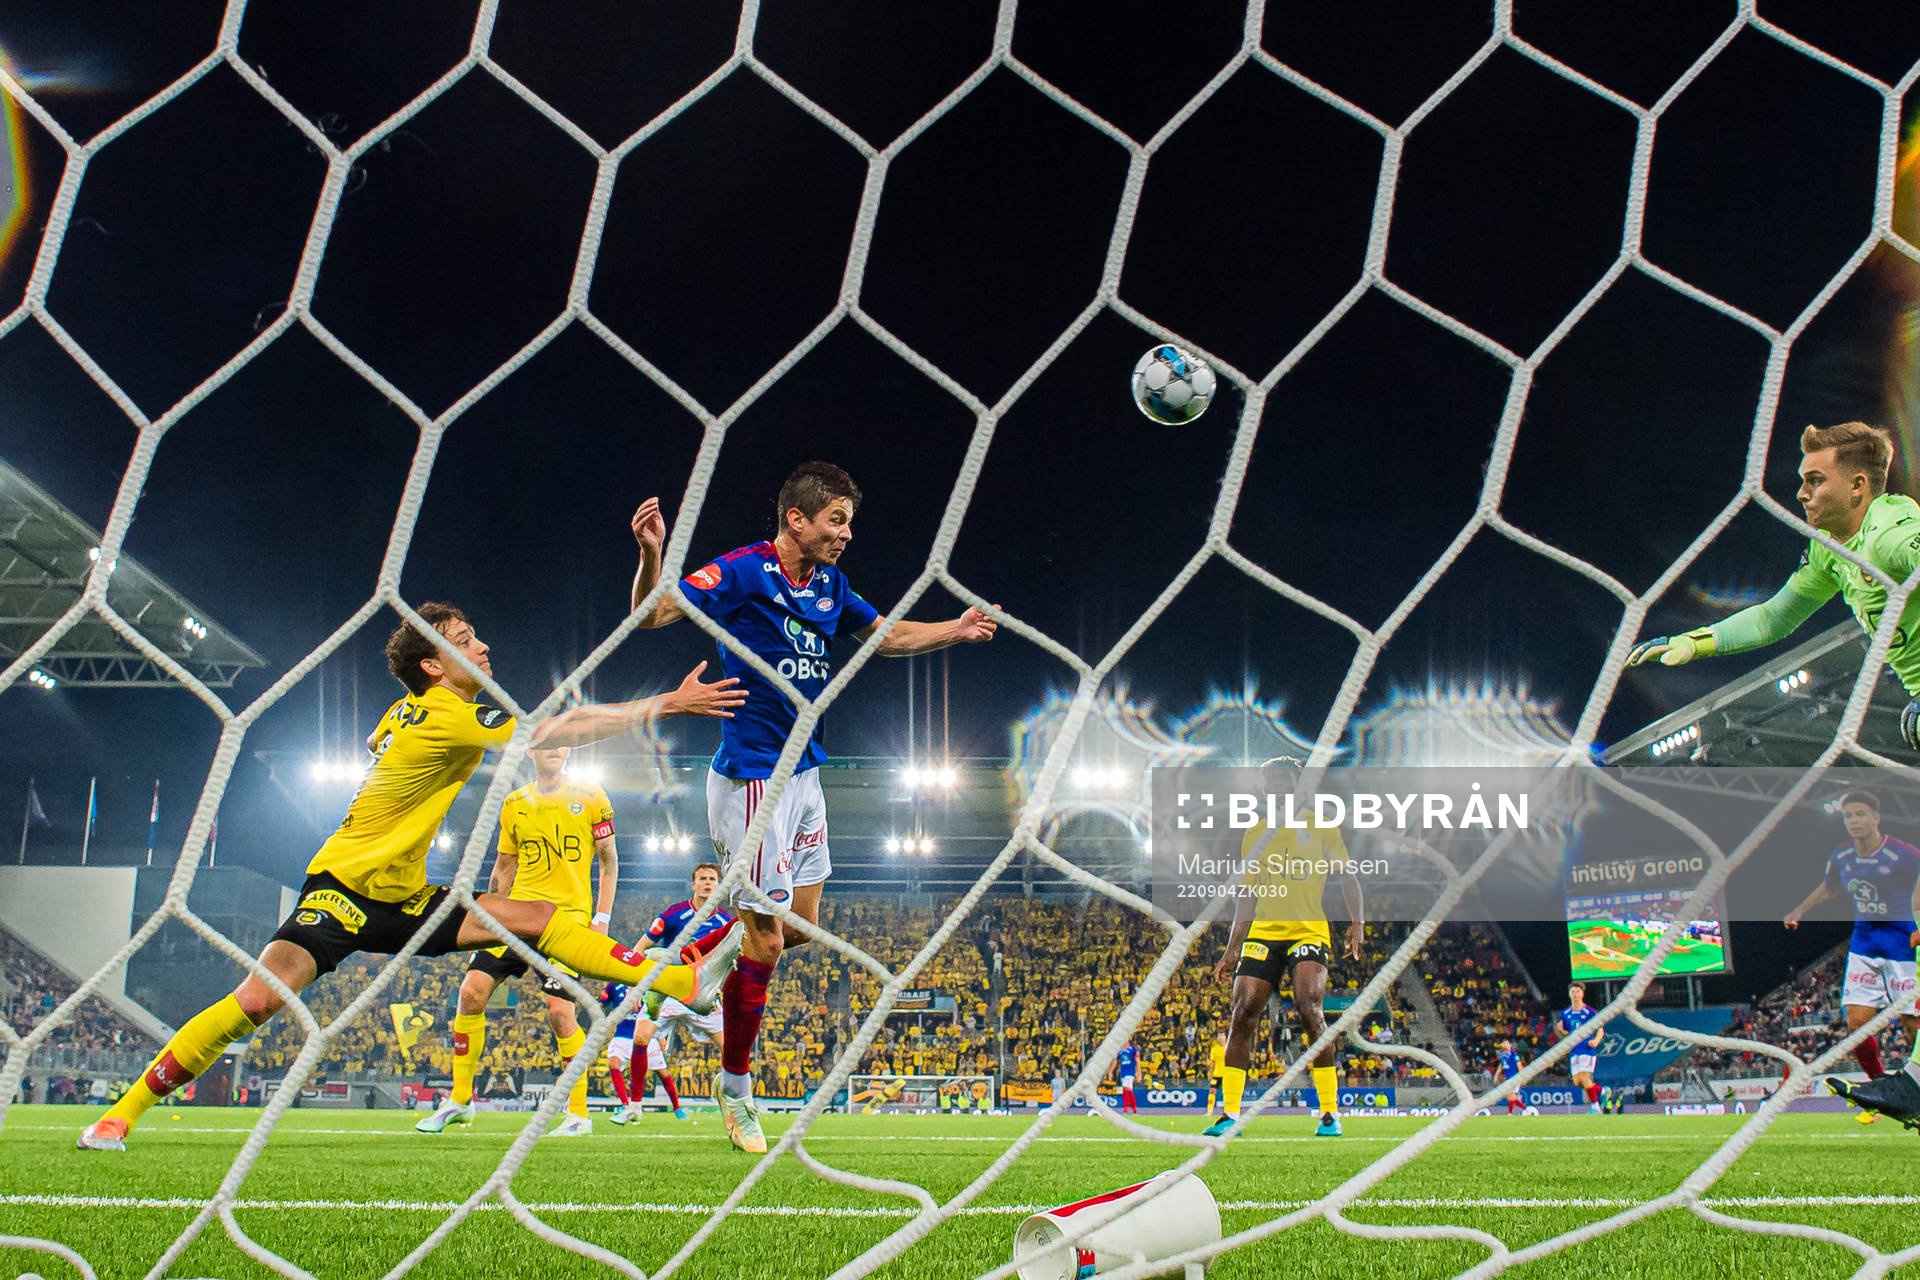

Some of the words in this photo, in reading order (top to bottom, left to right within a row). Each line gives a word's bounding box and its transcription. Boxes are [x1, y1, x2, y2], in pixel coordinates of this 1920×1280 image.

[520, 823, 581, 872] DNB
[1571, 861, 1637, 884] intility
[1643, 857, 1704, 877] arena
[1146, 1089, 1198, 1106] coop
[1530, 1091, 1574, 1106] OBOS
